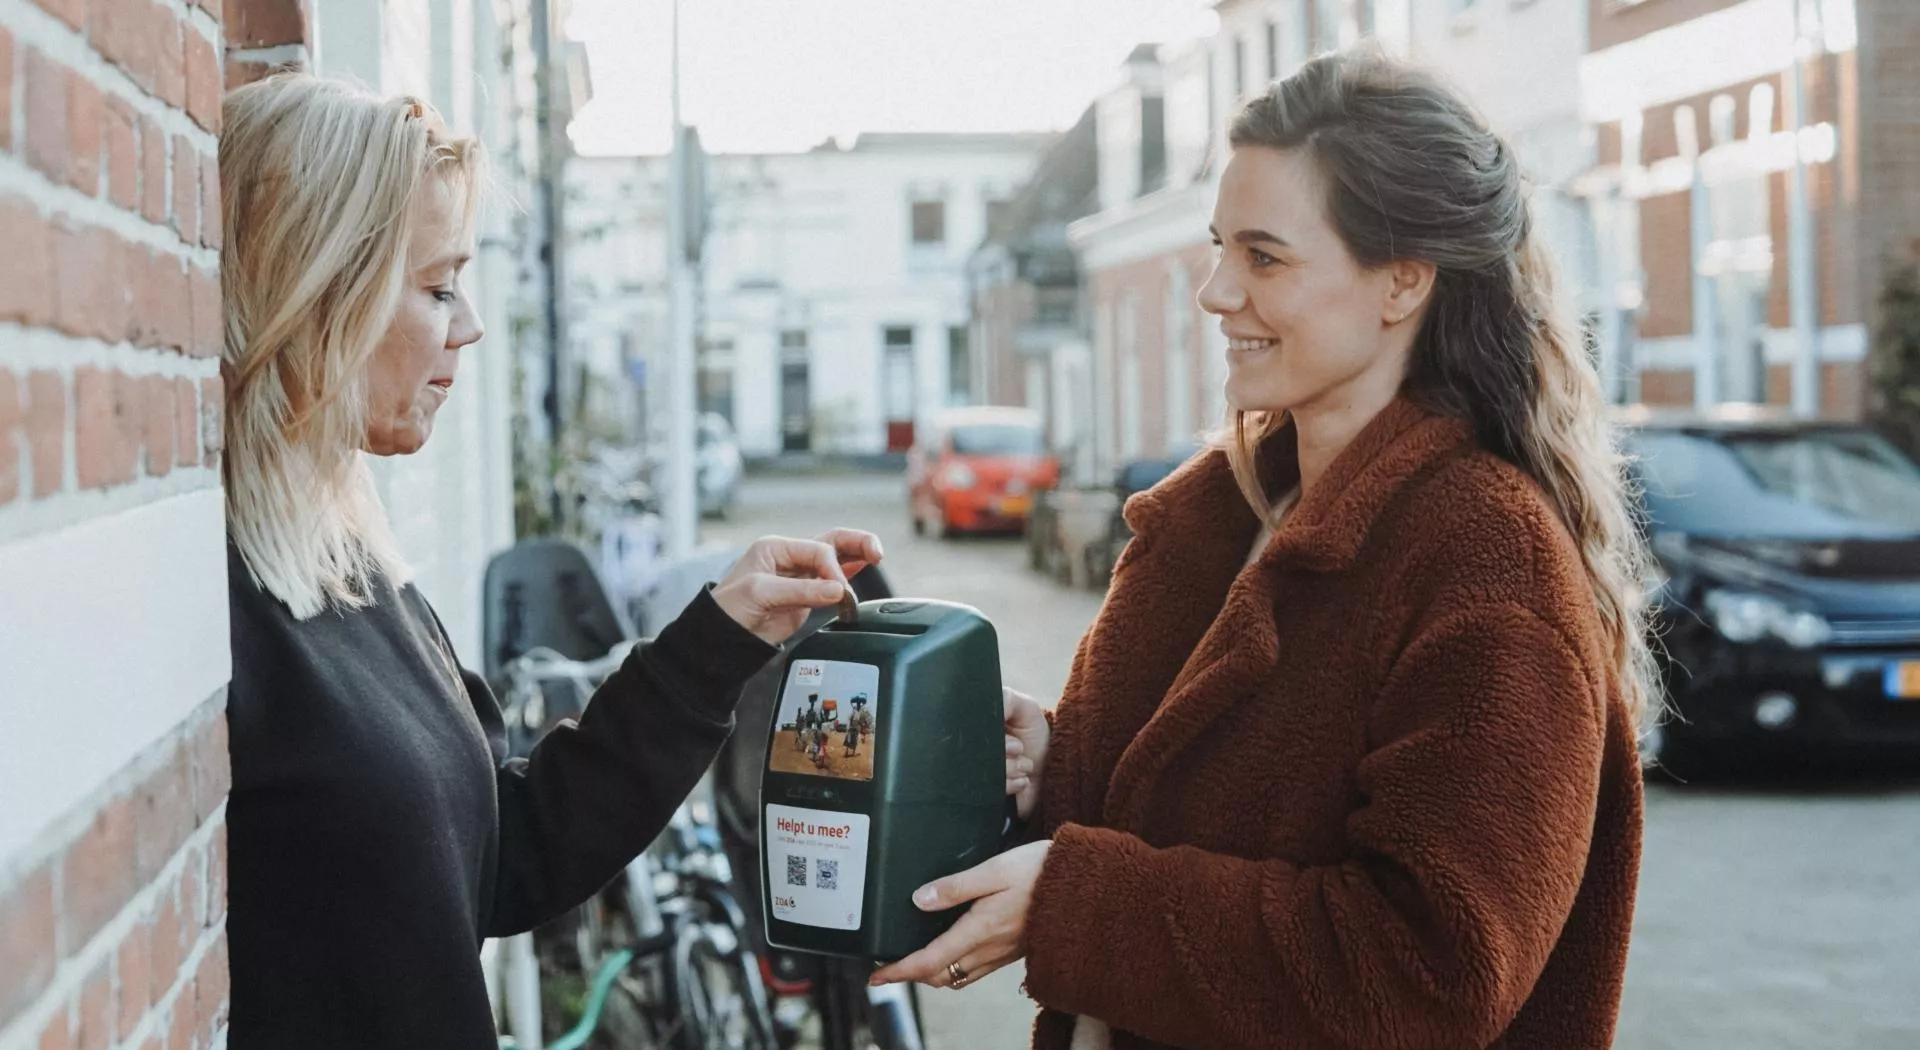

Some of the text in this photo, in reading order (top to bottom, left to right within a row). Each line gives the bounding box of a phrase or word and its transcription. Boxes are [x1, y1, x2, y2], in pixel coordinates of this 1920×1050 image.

[777, 817, 850, 839] Helpt u mee?
